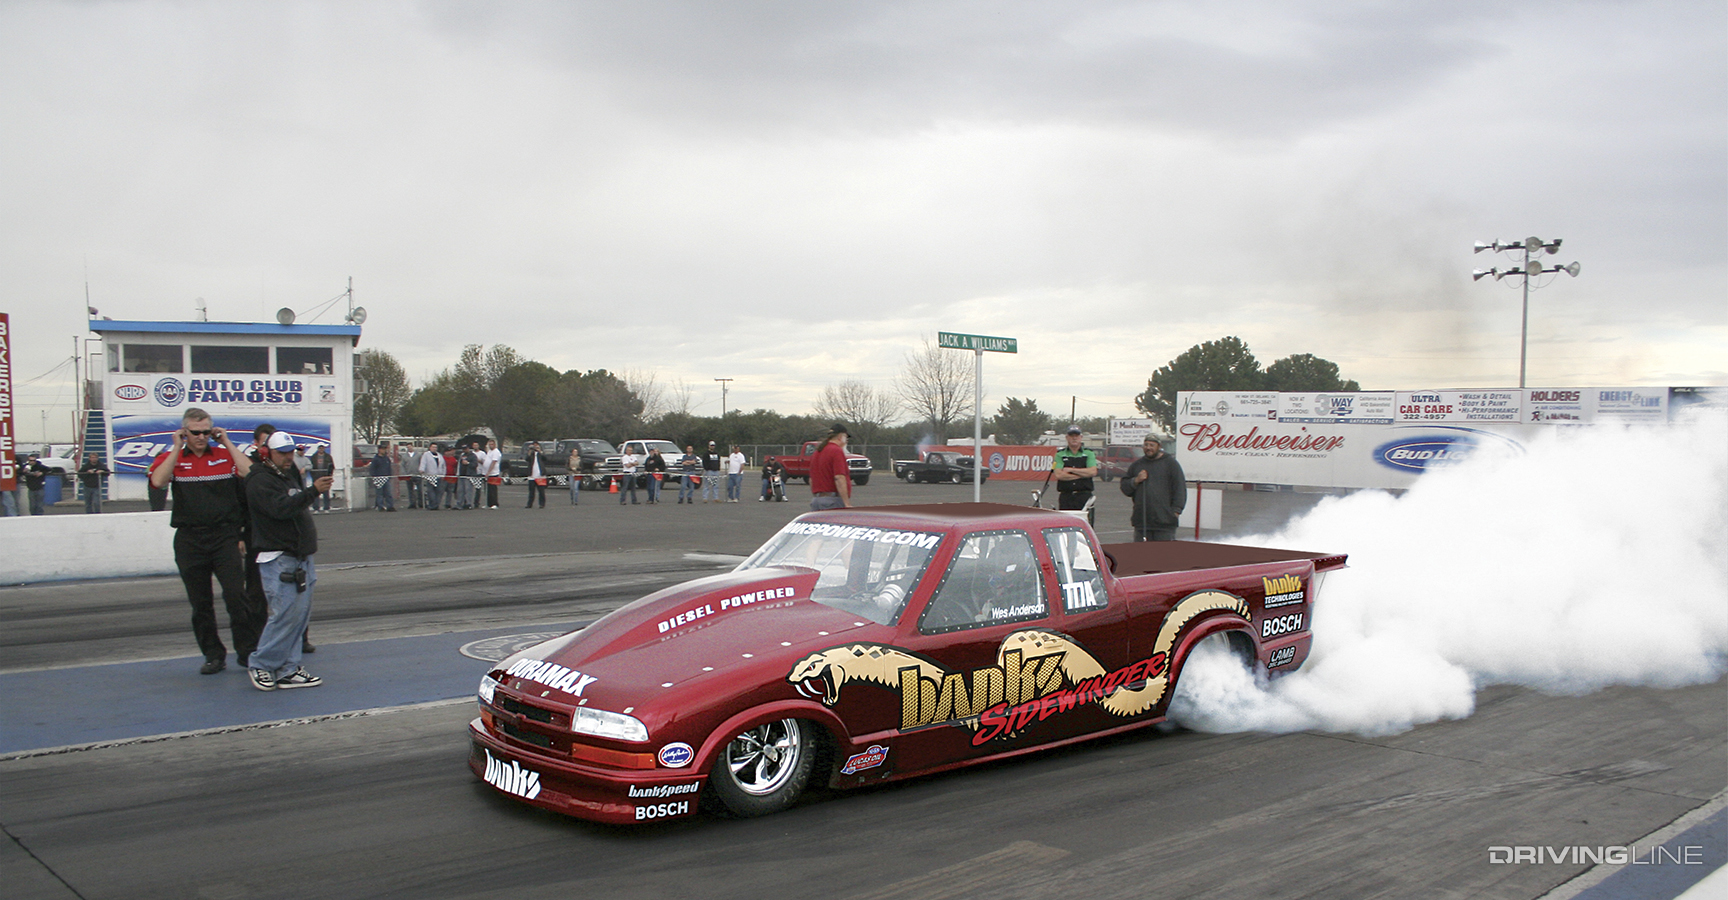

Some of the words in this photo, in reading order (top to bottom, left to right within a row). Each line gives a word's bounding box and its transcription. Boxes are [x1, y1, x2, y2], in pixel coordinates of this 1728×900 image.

[940, 334, 958, 346] JACK
[962, 336, 968, 348] A
[971, 337, 1008, 350] WILLIAMS
[117, 387, 146, 398] NHRA
[190, 380, 244, 391] AUTO
[250, 380, 302, 392] CLUB
[0, 322, 14, 479] BAKERSFIELD
[188, 392, 302, 403] FAMOSO
[1330, 398, 1354, 407] WAY
[1530, 391, 1580, 402] HOLDERS
[1600, 391, 1633, 401] ENERGY
[1400, 405, 1420, 414] CAR
[1424, 405, 1452, 414] CARE
[1179, 422, 1346, 452] Budweiser
[1391, 449, 1433, 460] BUD
[1005, 455, 1030, 471] AUTO
[1031, 455, 1054, 472] CLUB
[1262, 573, 1302, 596] banks
[1264, 591, 1304, 605] TECHNOLOGIES
[658, 604, 715, 634] DIESEL
[720, 587, 795, 610] POWERED
[992, 607, 1008, 619] Wes
[1008, 604, 1045, 617] Anderson
[1262, 614, 1303, 637] BOSCH
[1271, 646, 1296, 662] LAMB
[506, 658, 599, 697] DURAMAX
[900, 650, 1065, 730] banks
[972, 652, 1167, 746] SIDEWINDER
[484, 748, 541, 800] banks
[635, 801, 689, 820] BOSCH
